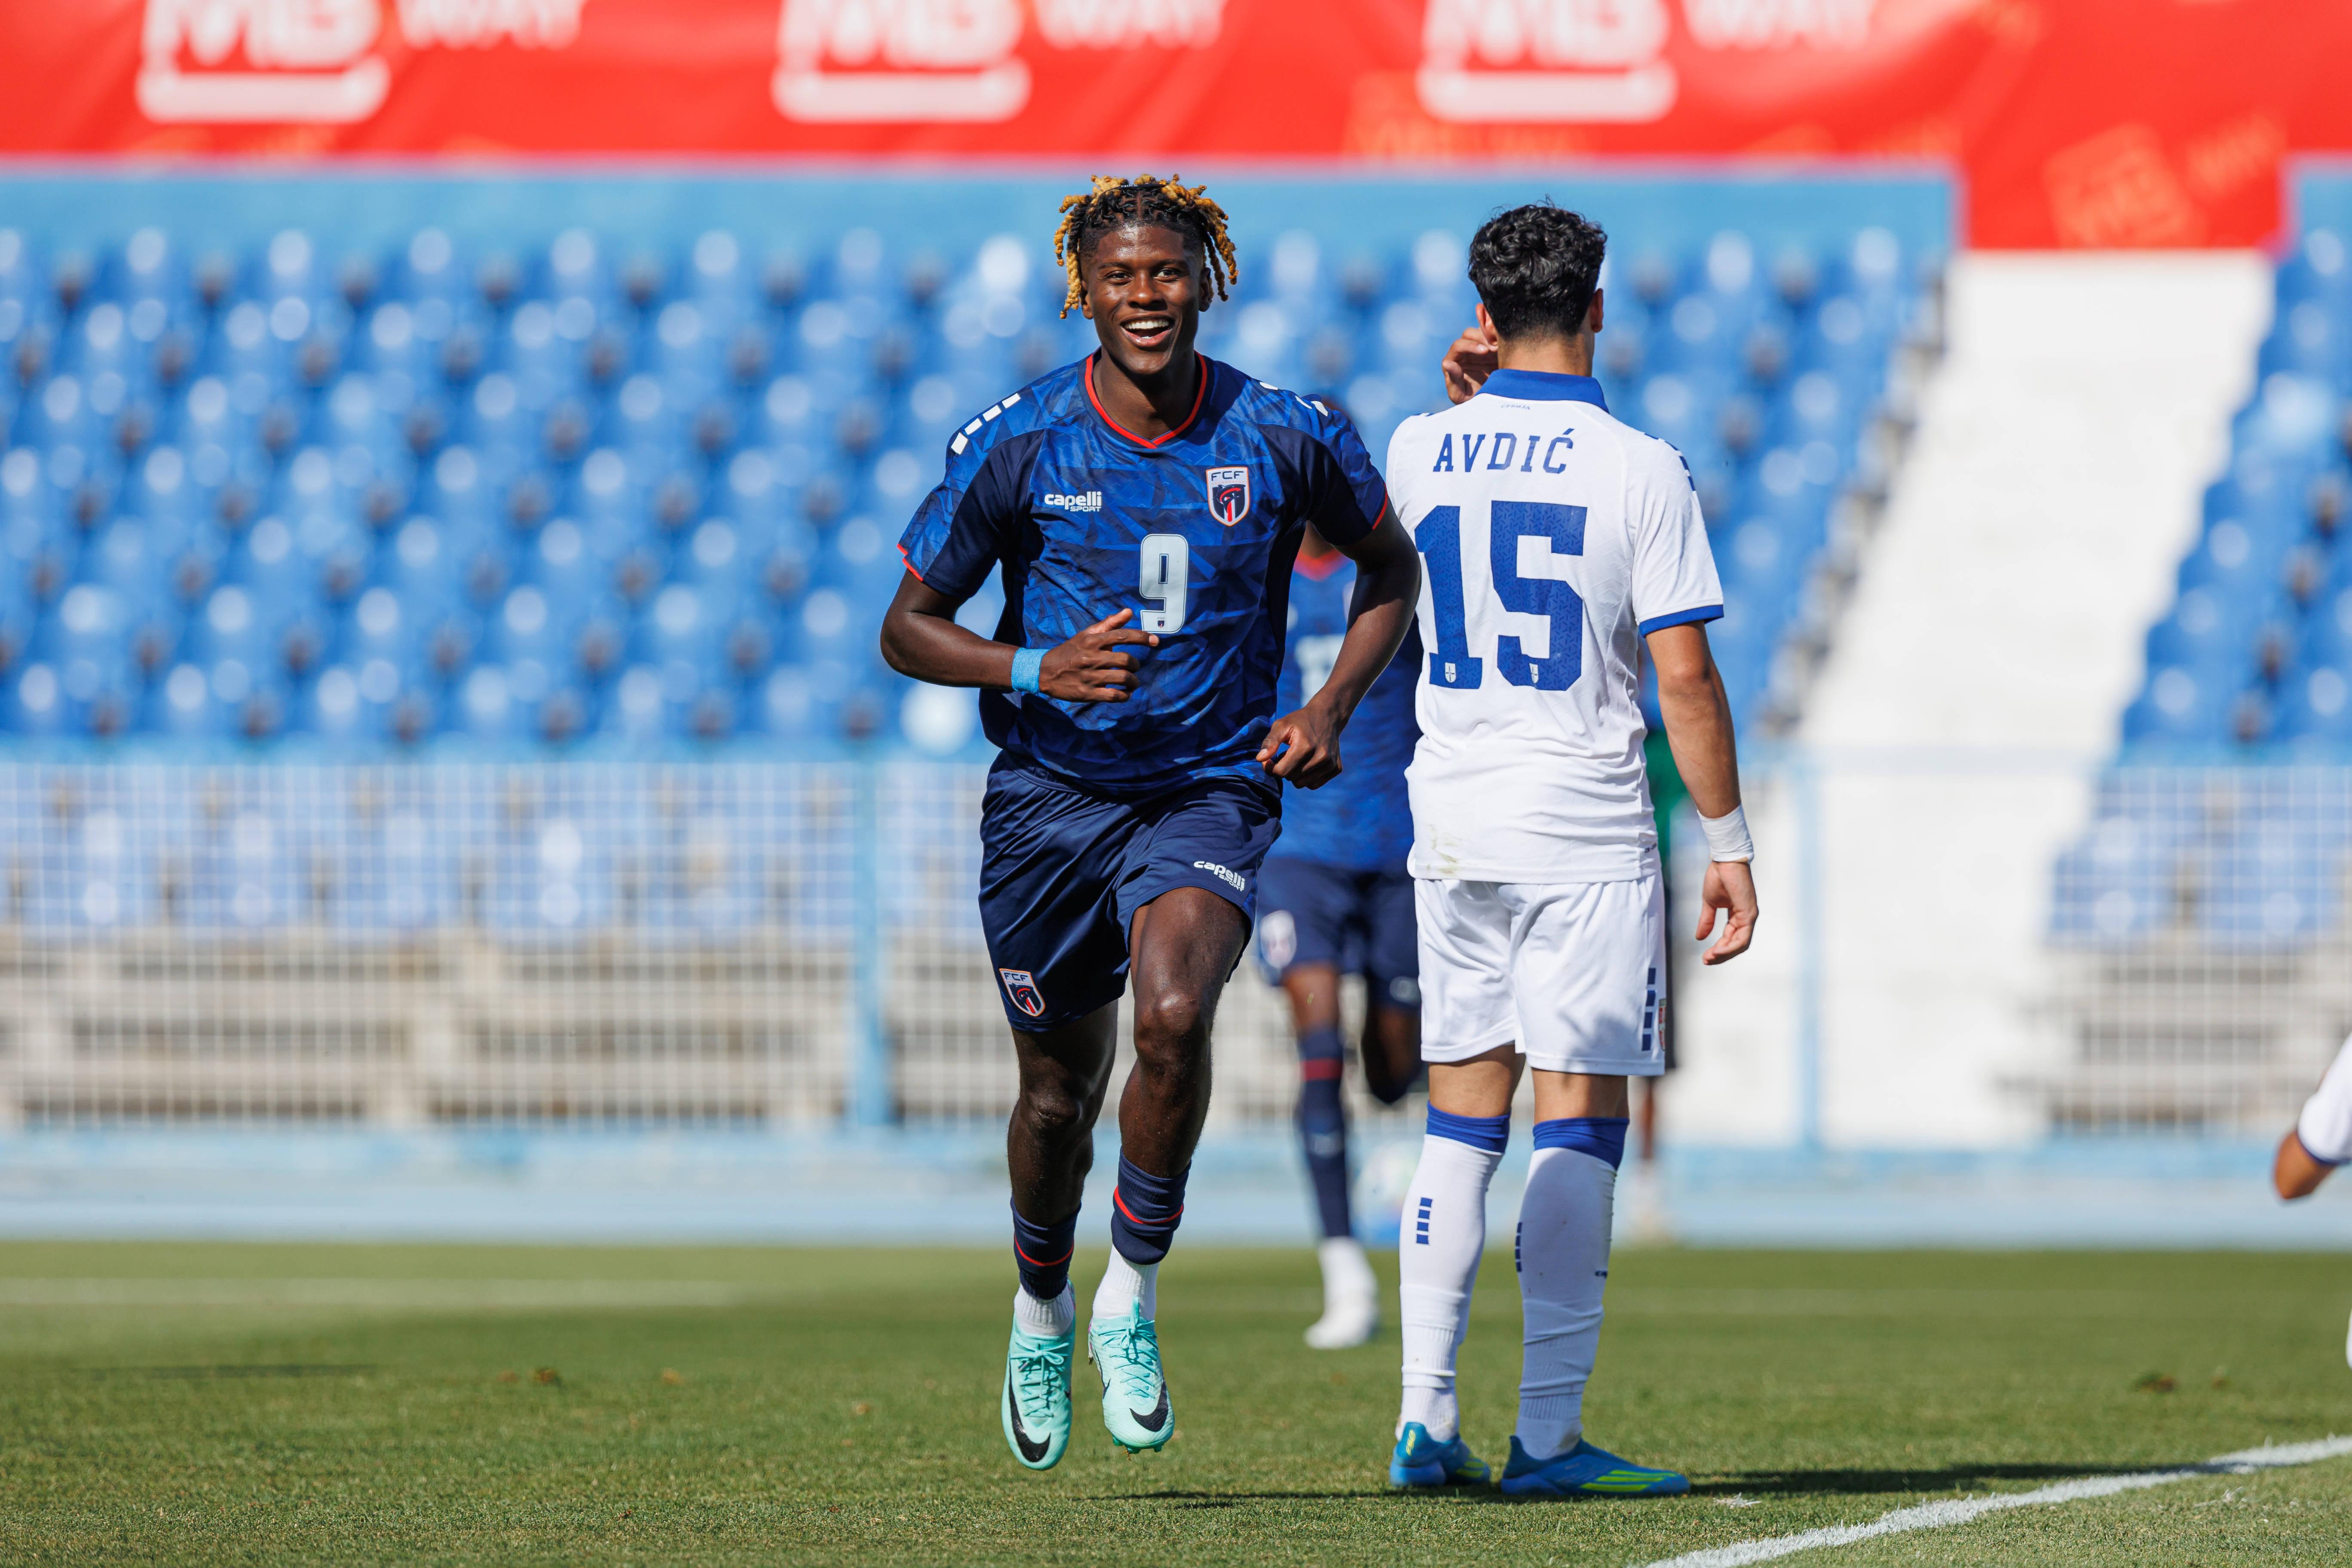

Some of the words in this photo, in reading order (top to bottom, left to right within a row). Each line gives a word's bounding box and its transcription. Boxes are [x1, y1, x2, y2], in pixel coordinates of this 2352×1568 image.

[1433, 428, 1575, 474] AVDIĆ
[1211, 471, 1244, 481] FCF
[1044, 491, 1102, 510] capelli
[1139, 533, 1188, 634] 9
[1414, 500, 1588, 691] 15
[1193, 861, 1245, 889] capelli
[1218, 873, 1244, 892] SPORT
[1004, 972, 1028, 981] FCF
